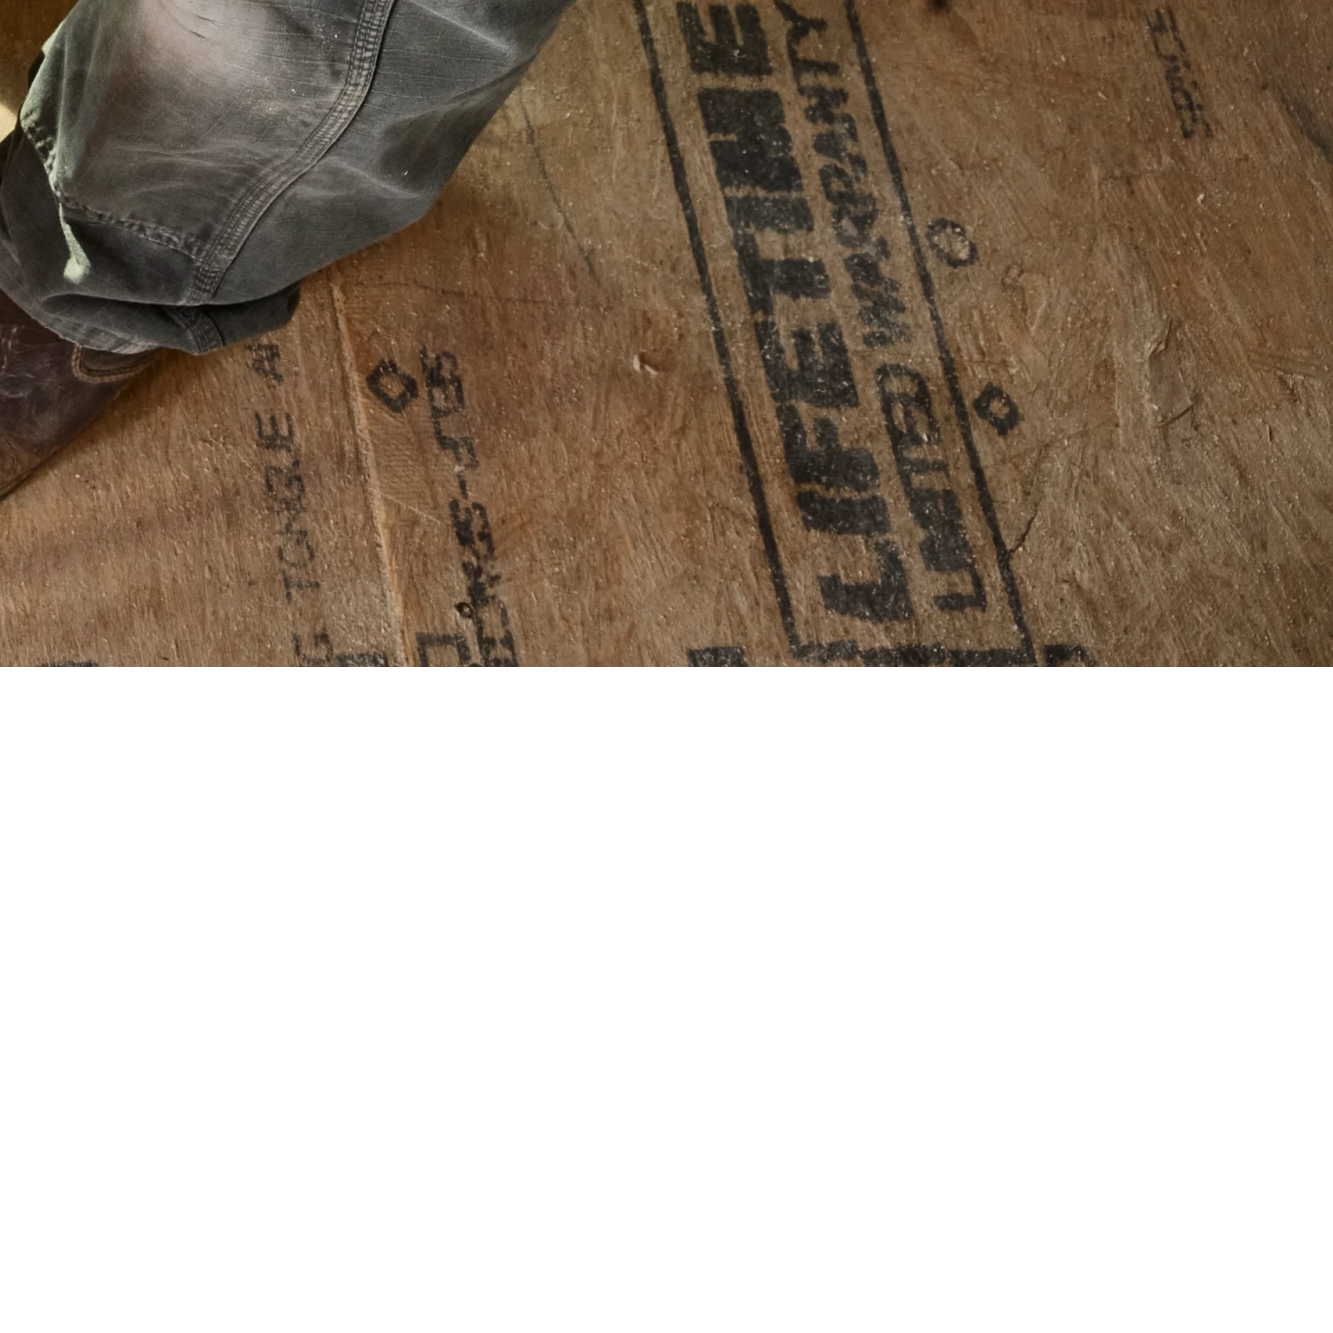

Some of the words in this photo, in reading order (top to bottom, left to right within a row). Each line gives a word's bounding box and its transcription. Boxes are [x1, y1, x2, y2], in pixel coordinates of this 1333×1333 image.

[1141, 4, 1214, 138] SPACE
[676, 1, 916, 621] LIFETIME
[256, 411, 320, 603] TONGUE
[875, 362, 987, 612] LIMITED
